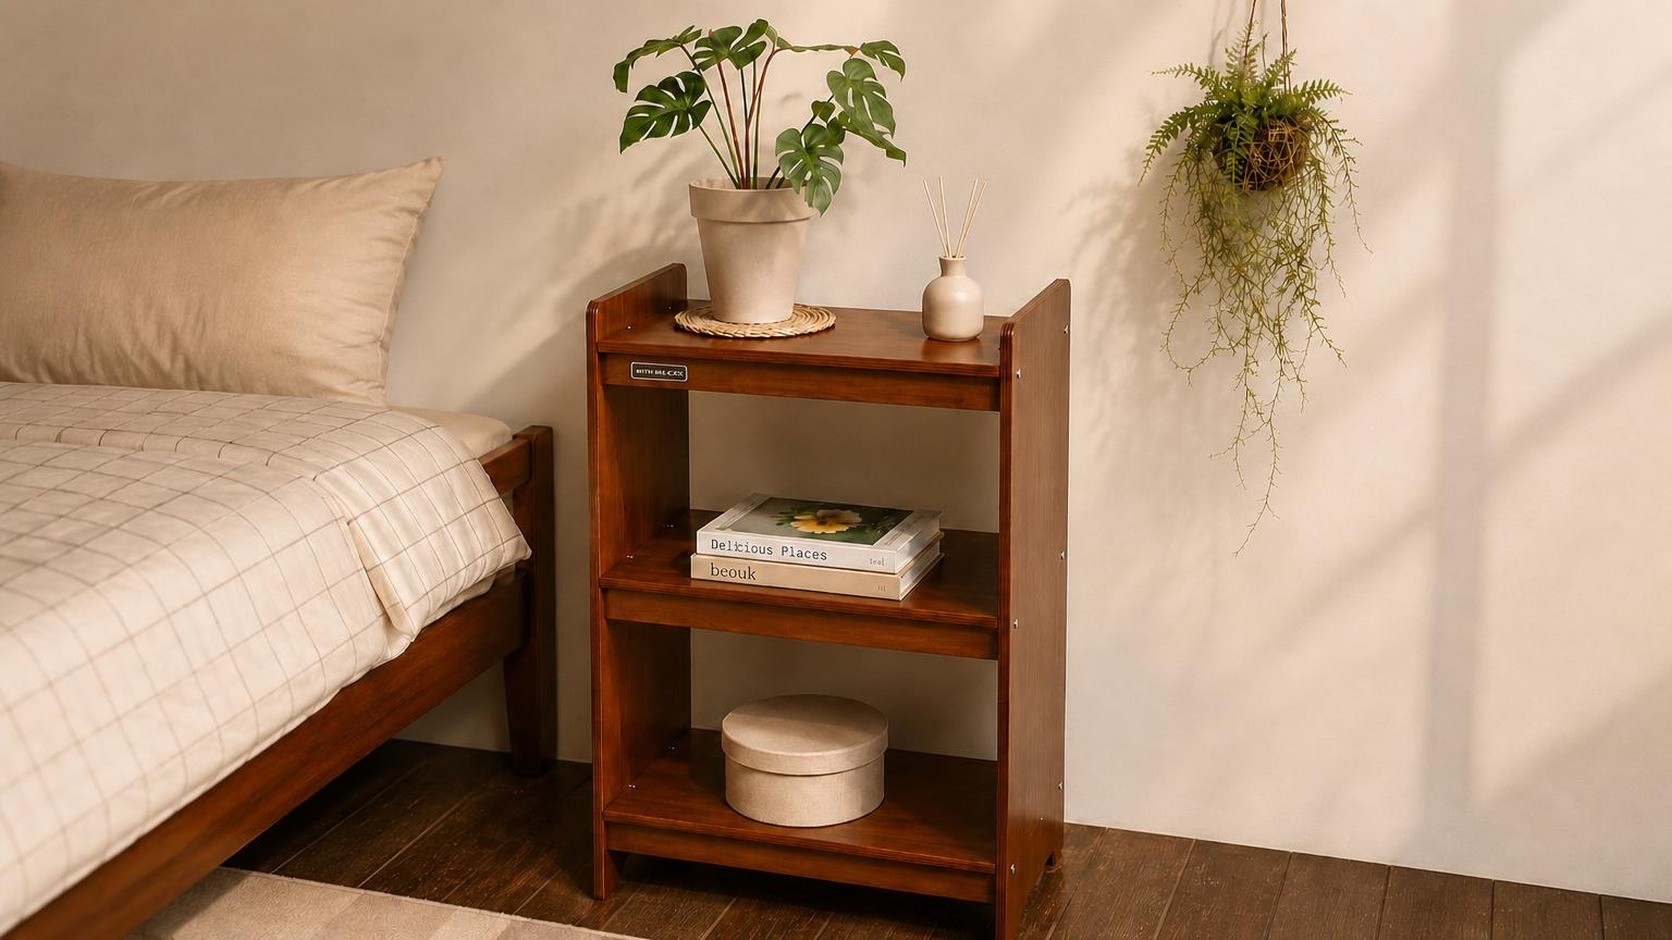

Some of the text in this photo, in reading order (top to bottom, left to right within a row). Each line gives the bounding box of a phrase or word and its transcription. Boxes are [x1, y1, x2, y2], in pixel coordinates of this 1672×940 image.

[711, 539, 828, 561] Delicious Places
[711, 563, 756, 581] beouk
